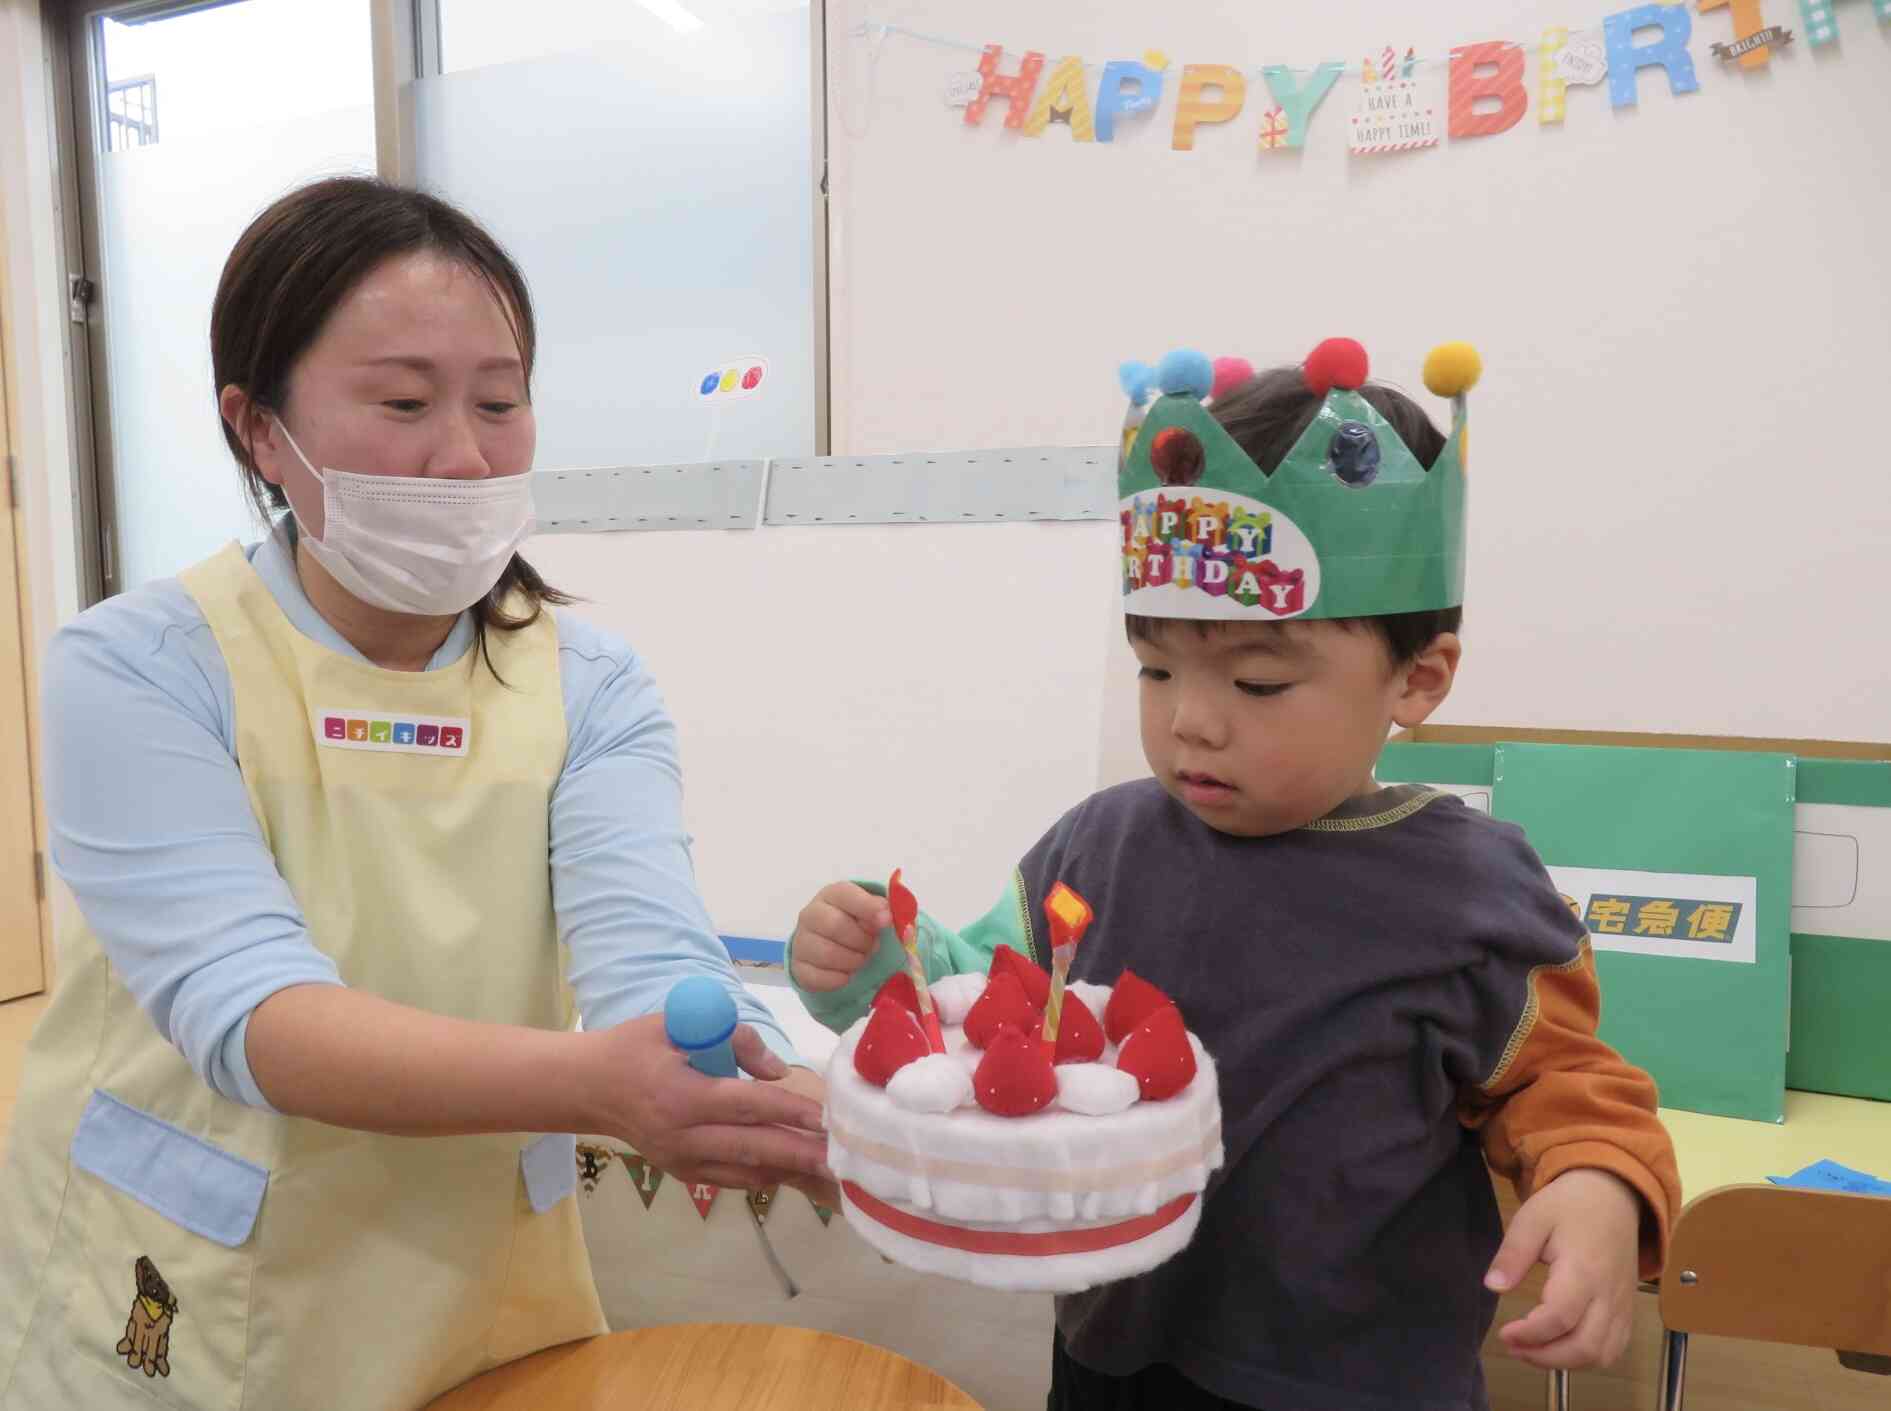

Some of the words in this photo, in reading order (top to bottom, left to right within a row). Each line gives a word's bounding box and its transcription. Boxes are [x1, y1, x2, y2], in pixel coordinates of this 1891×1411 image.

[963, 44, 1346, 151] HAPPY
[1367, 94, 1398, 111] HAVE
[1404, 92, 1414, 108] A
[1355, 127, 1392, 142] HAPPY
[1399, 120, 1431, 138] TIME!
[328, 722, 464, 748] ニチイキッズ
[1587, 898, 1735, 940] 宅急便
